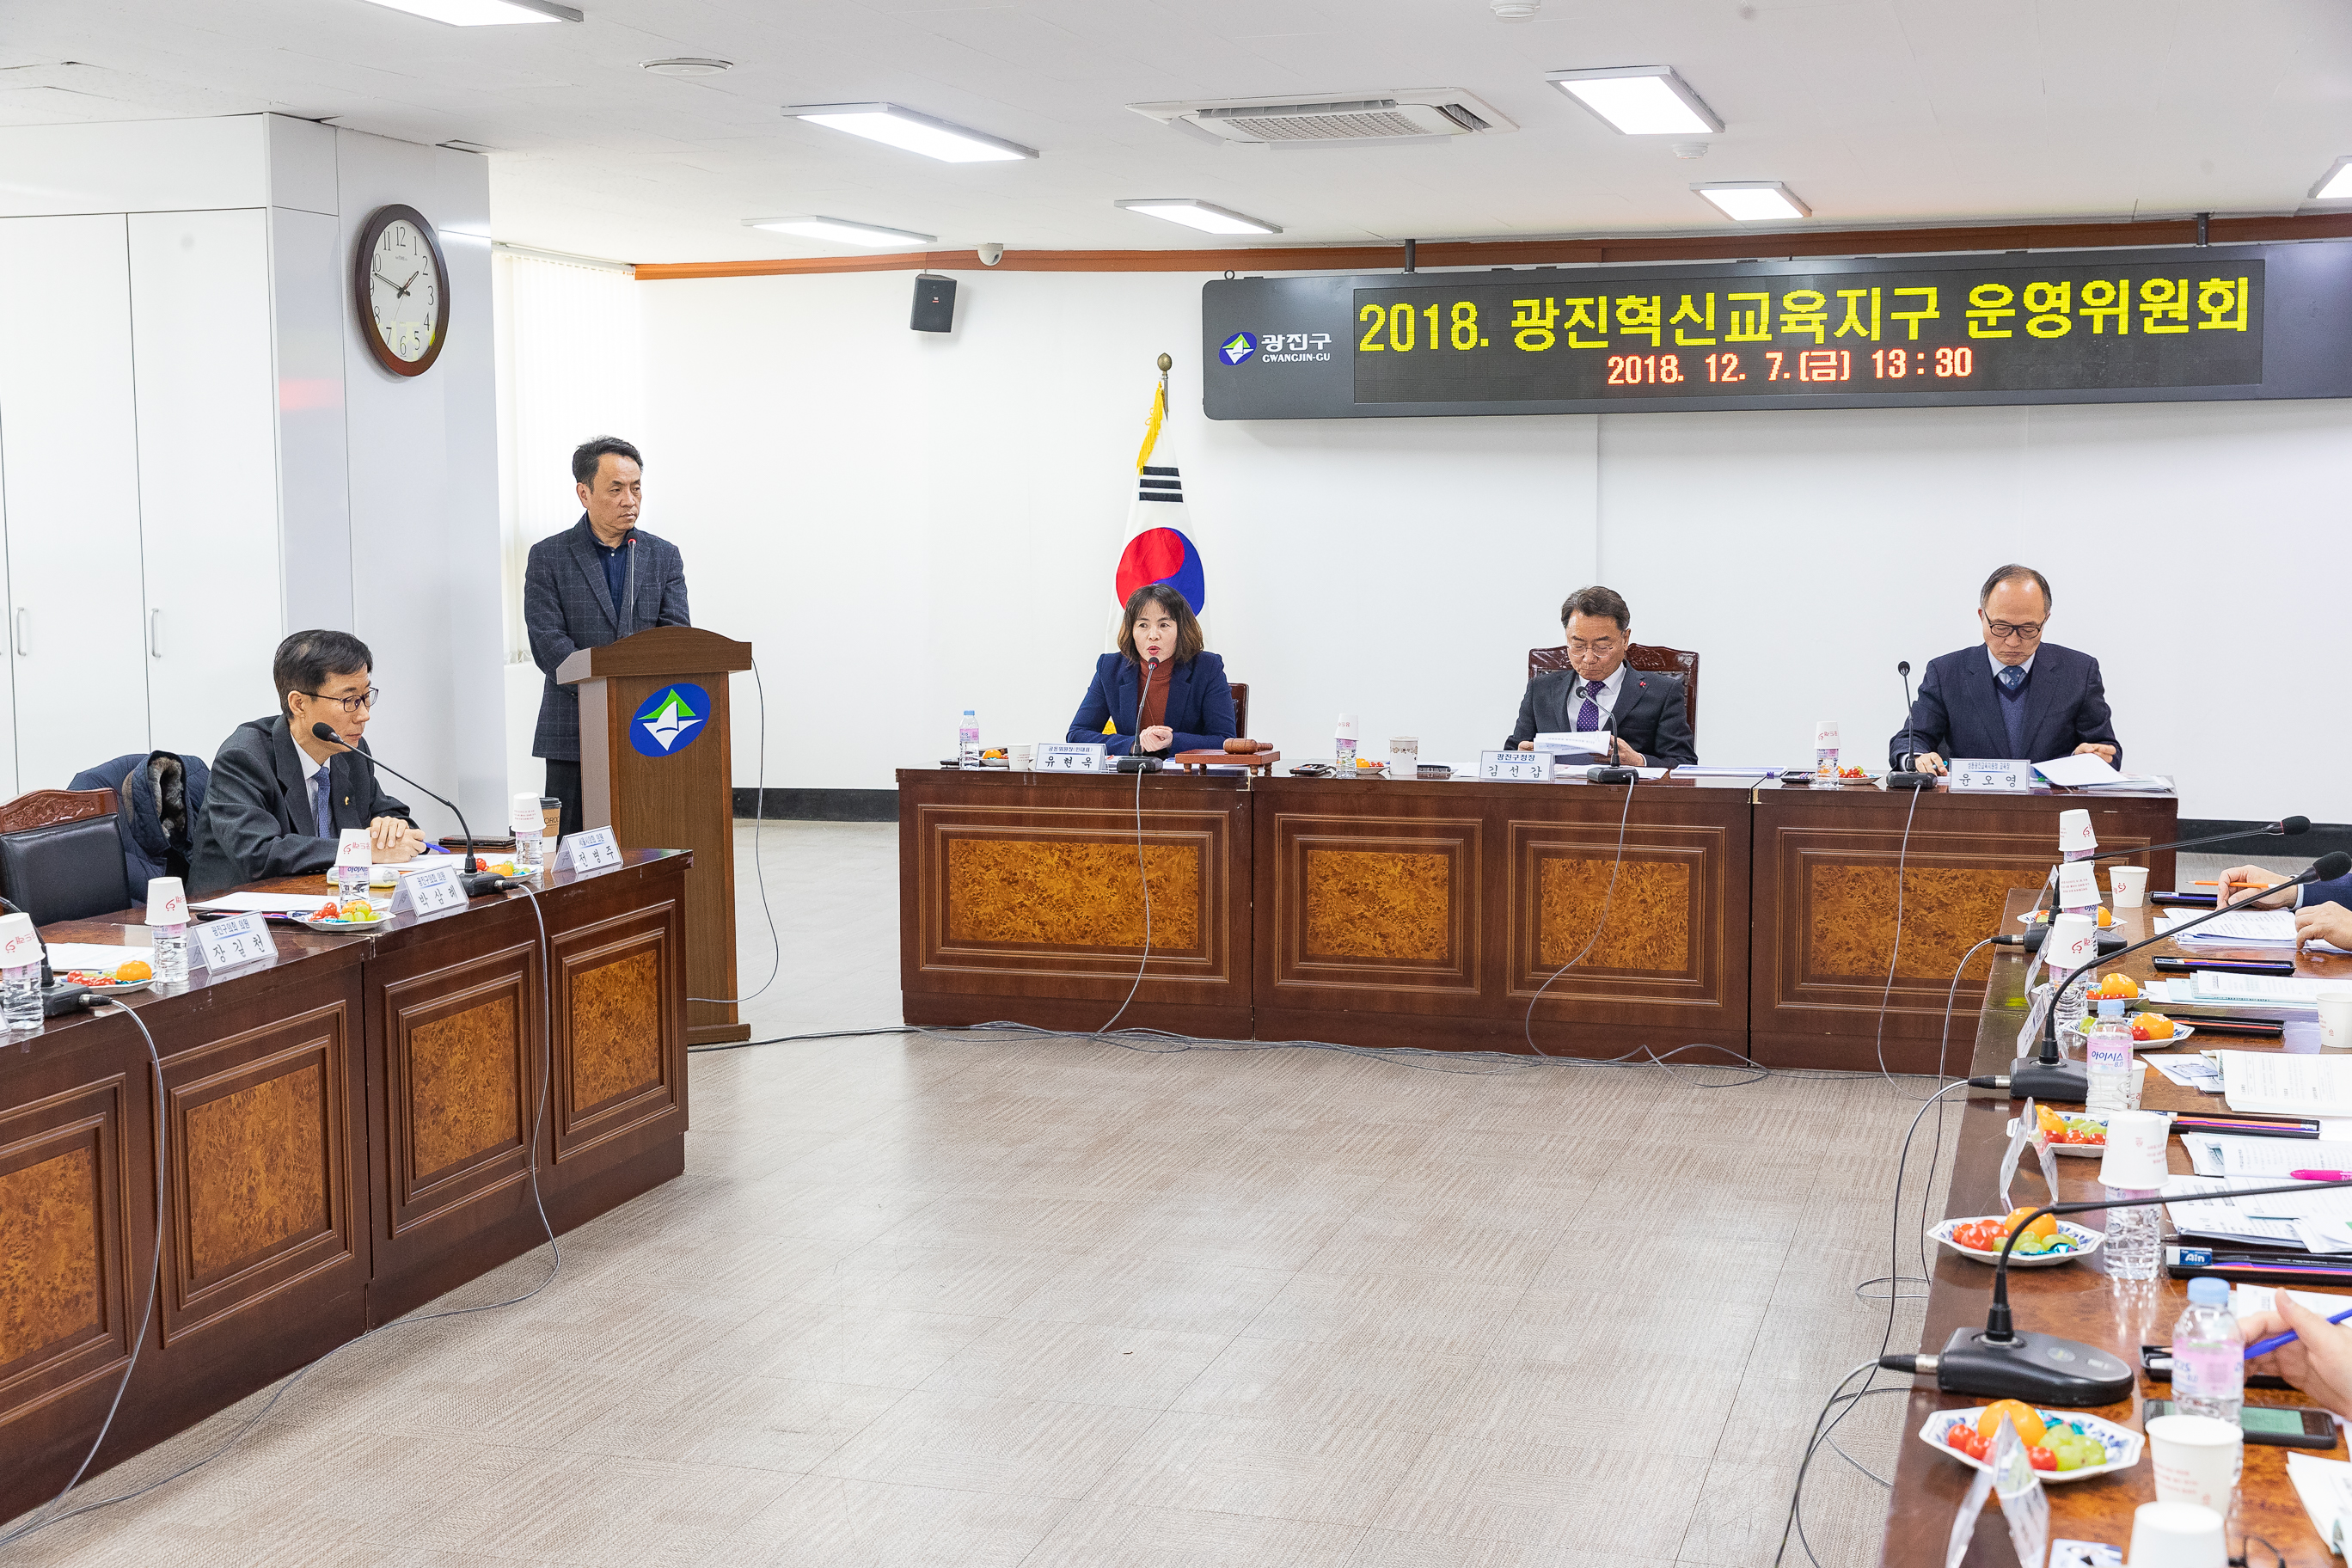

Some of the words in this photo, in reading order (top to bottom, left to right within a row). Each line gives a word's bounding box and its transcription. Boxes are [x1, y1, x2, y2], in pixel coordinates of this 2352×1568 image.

[383, 230, 392, 252] 11
[395, 226, 407, 248] 12
[413, 236, 418, 256] 1
[422, 255, 429, 276] 2
[427, 285, 434, 306] 3
[374, 305, 381, 327] 8
[423, 311, 430, 332] 4
[1359, 301, 1489, 352] 2018.
[1511, 286, 1940, 352] 광진혁신교육지구
[1965, 277, 2249, 339] 운영위원회
[385, 327, 392, 346] 7
[399, 335, 407, 357] 6
[413, 330, 420, 351] 5
[1260, 333, 1332, 352] 광진구
[1261, 352, 1331, 363] GWANGJIN-GU
[1607, 353, 1685, 385] 2018.
[1705, 352, 1746, 383] 12.
[2091, 1050, 2123, 1062] 아이시스
[2184, 1253, 2205, 1263] Ain
